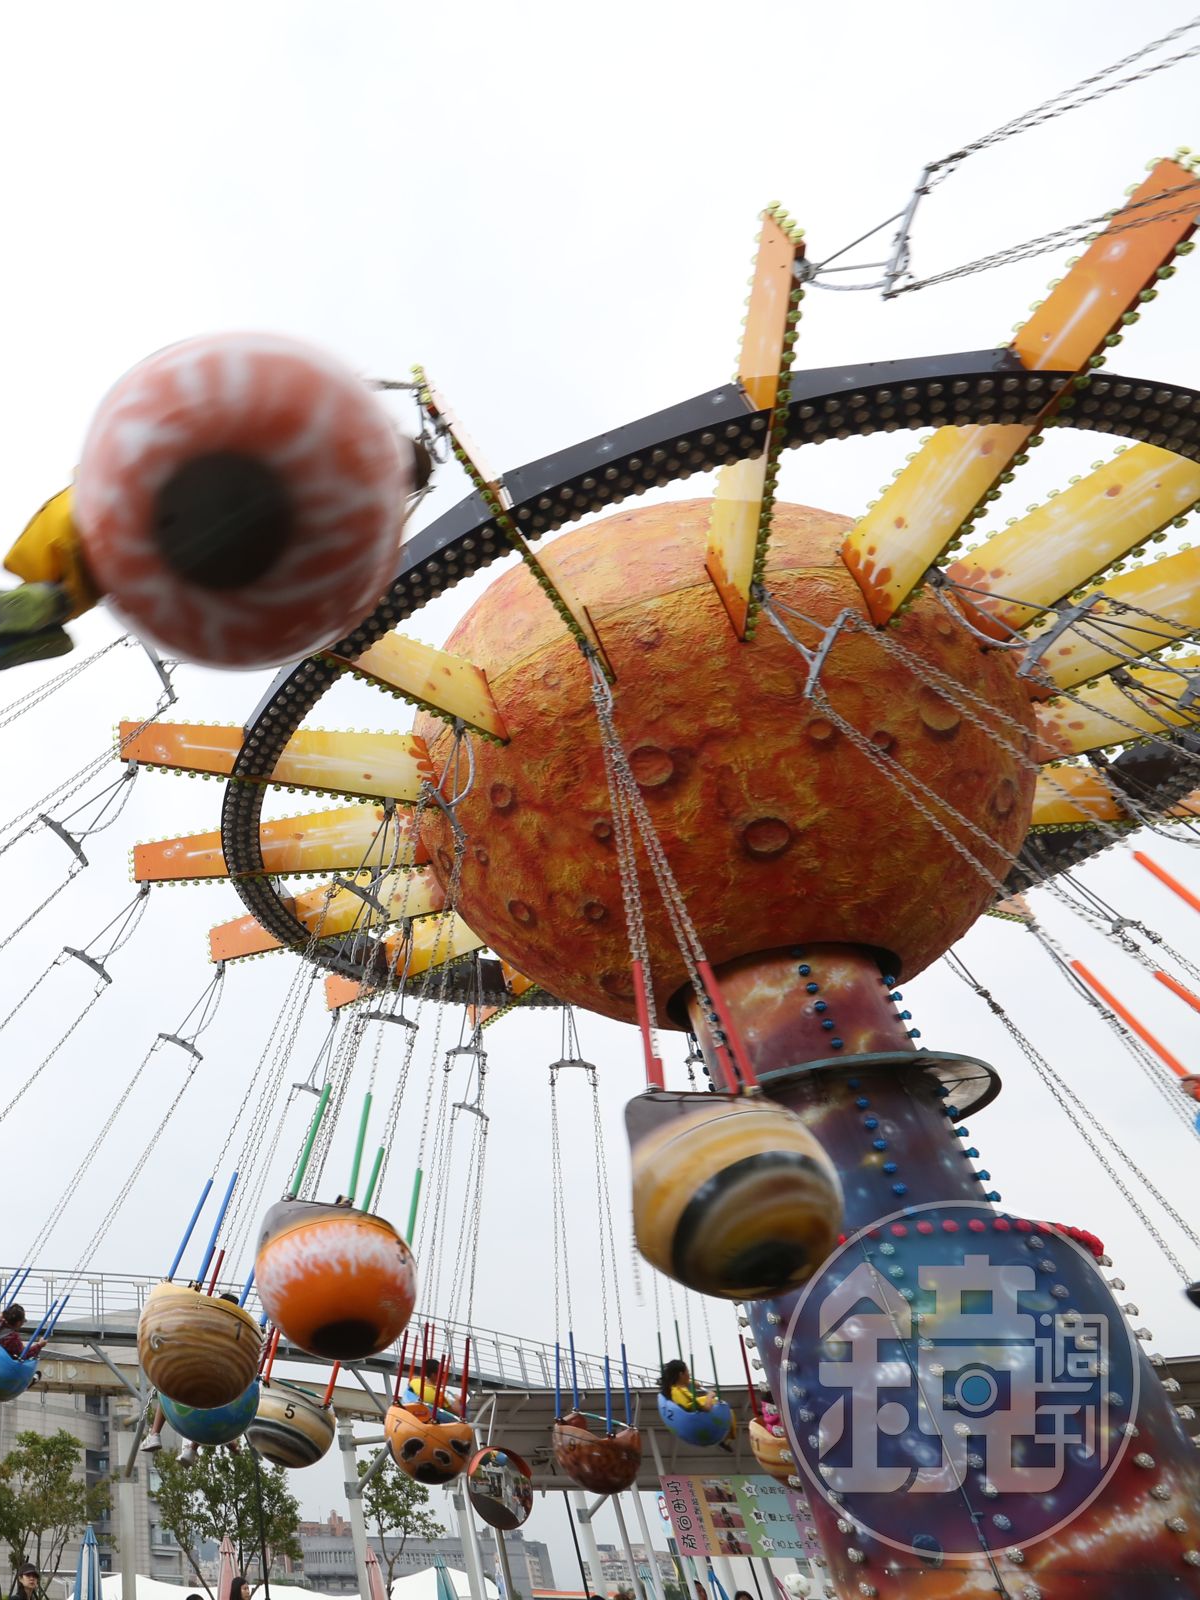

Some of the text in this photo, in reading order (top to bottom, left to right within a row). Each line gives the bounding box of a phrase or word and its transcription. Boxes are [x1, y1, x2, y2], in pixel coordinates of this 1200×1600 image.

[234, 1320, 243, 1341] 1
[284, 1403, 296, 1419] 5
[662, 1406, 675, 1421] 12
[394, 1419, 402, 1433] 7
[667, 1481, 698, 1549] 宇宙迴旋
